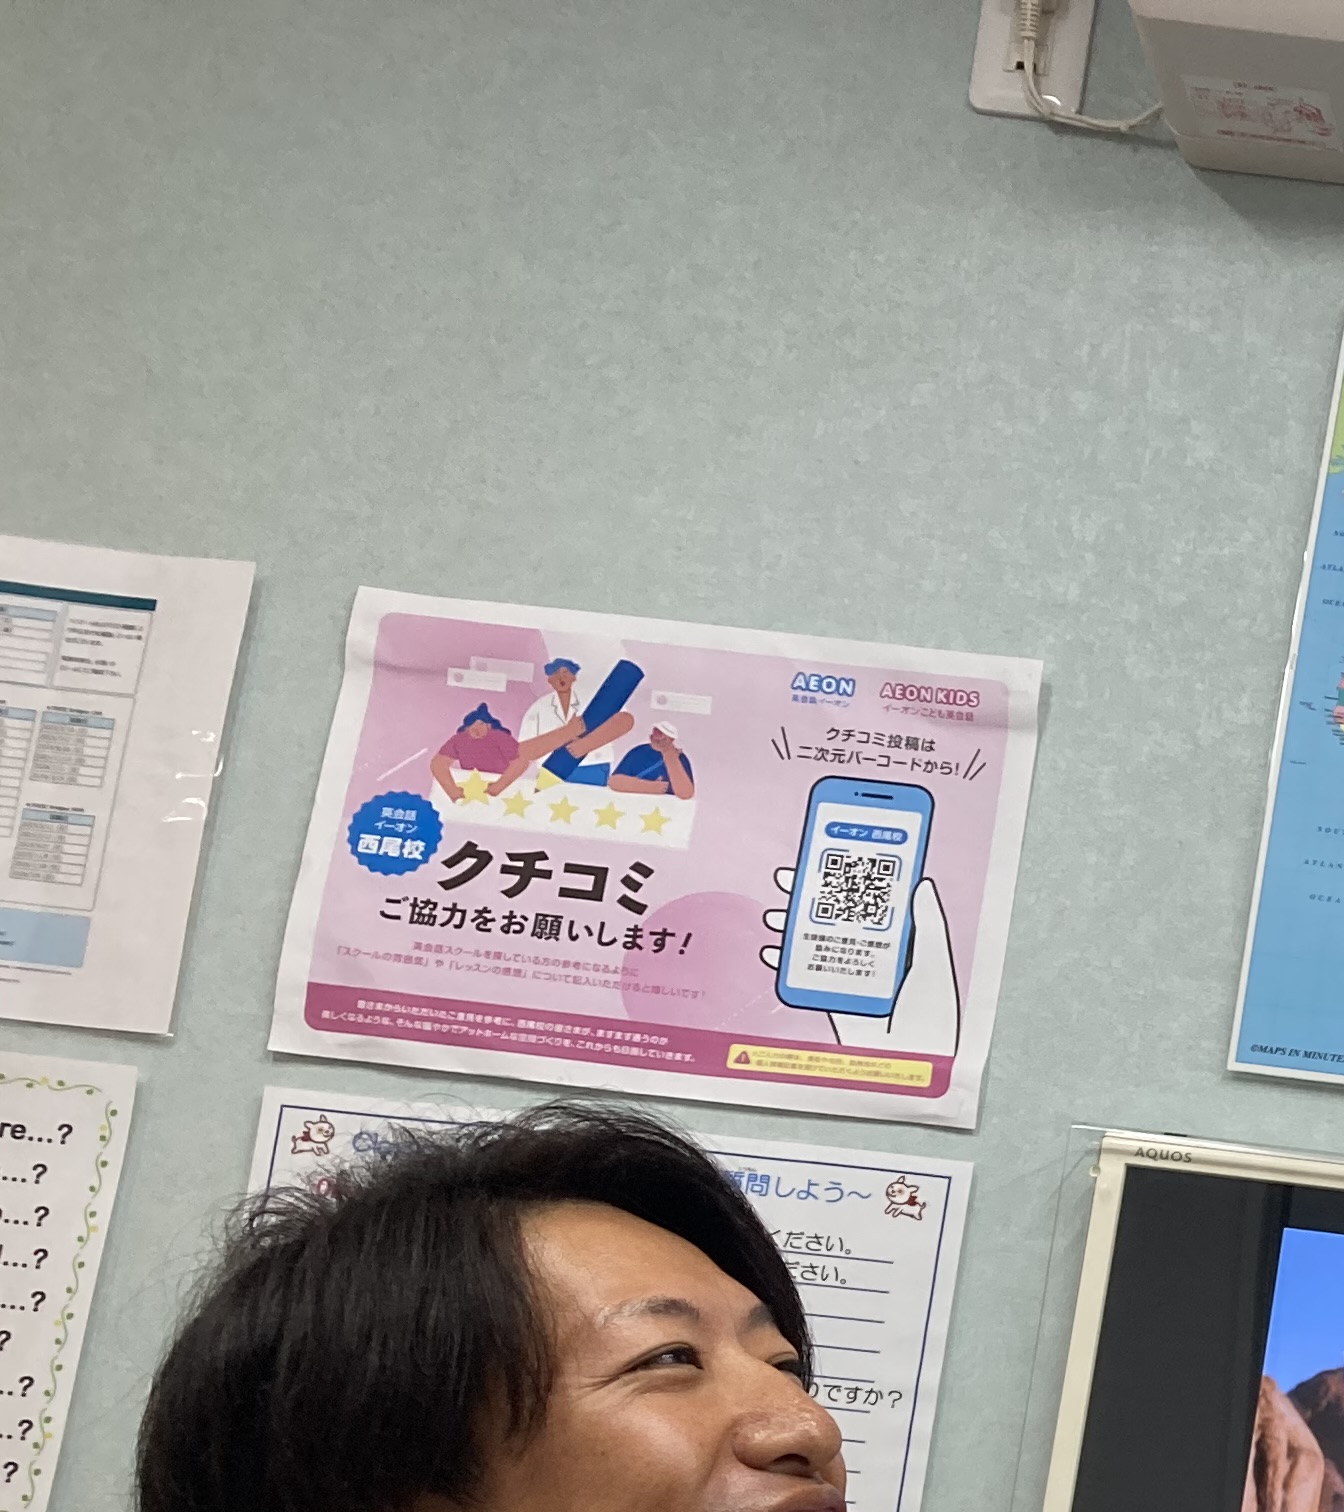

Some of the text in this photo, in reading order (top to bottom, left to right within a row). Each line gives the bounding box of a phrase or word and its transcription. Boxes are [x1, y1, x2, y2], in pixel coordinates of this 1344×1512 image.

[790, 671, 856, 697] AEON
[880, 682, 980, 708] AEON KIDS
[826, 727, 936, 752] クチコミ投稿は
[374, 821, 418, 834] イーオン
[831, 826, 868, 838] イーオン
[357, 833, 426, 860] 西尾校
[437, 840, 655, 916] クチコミ
[1288, 1048, 1302, 1058] IN
[1134, 1146, 1194, 1165] AQUOS
